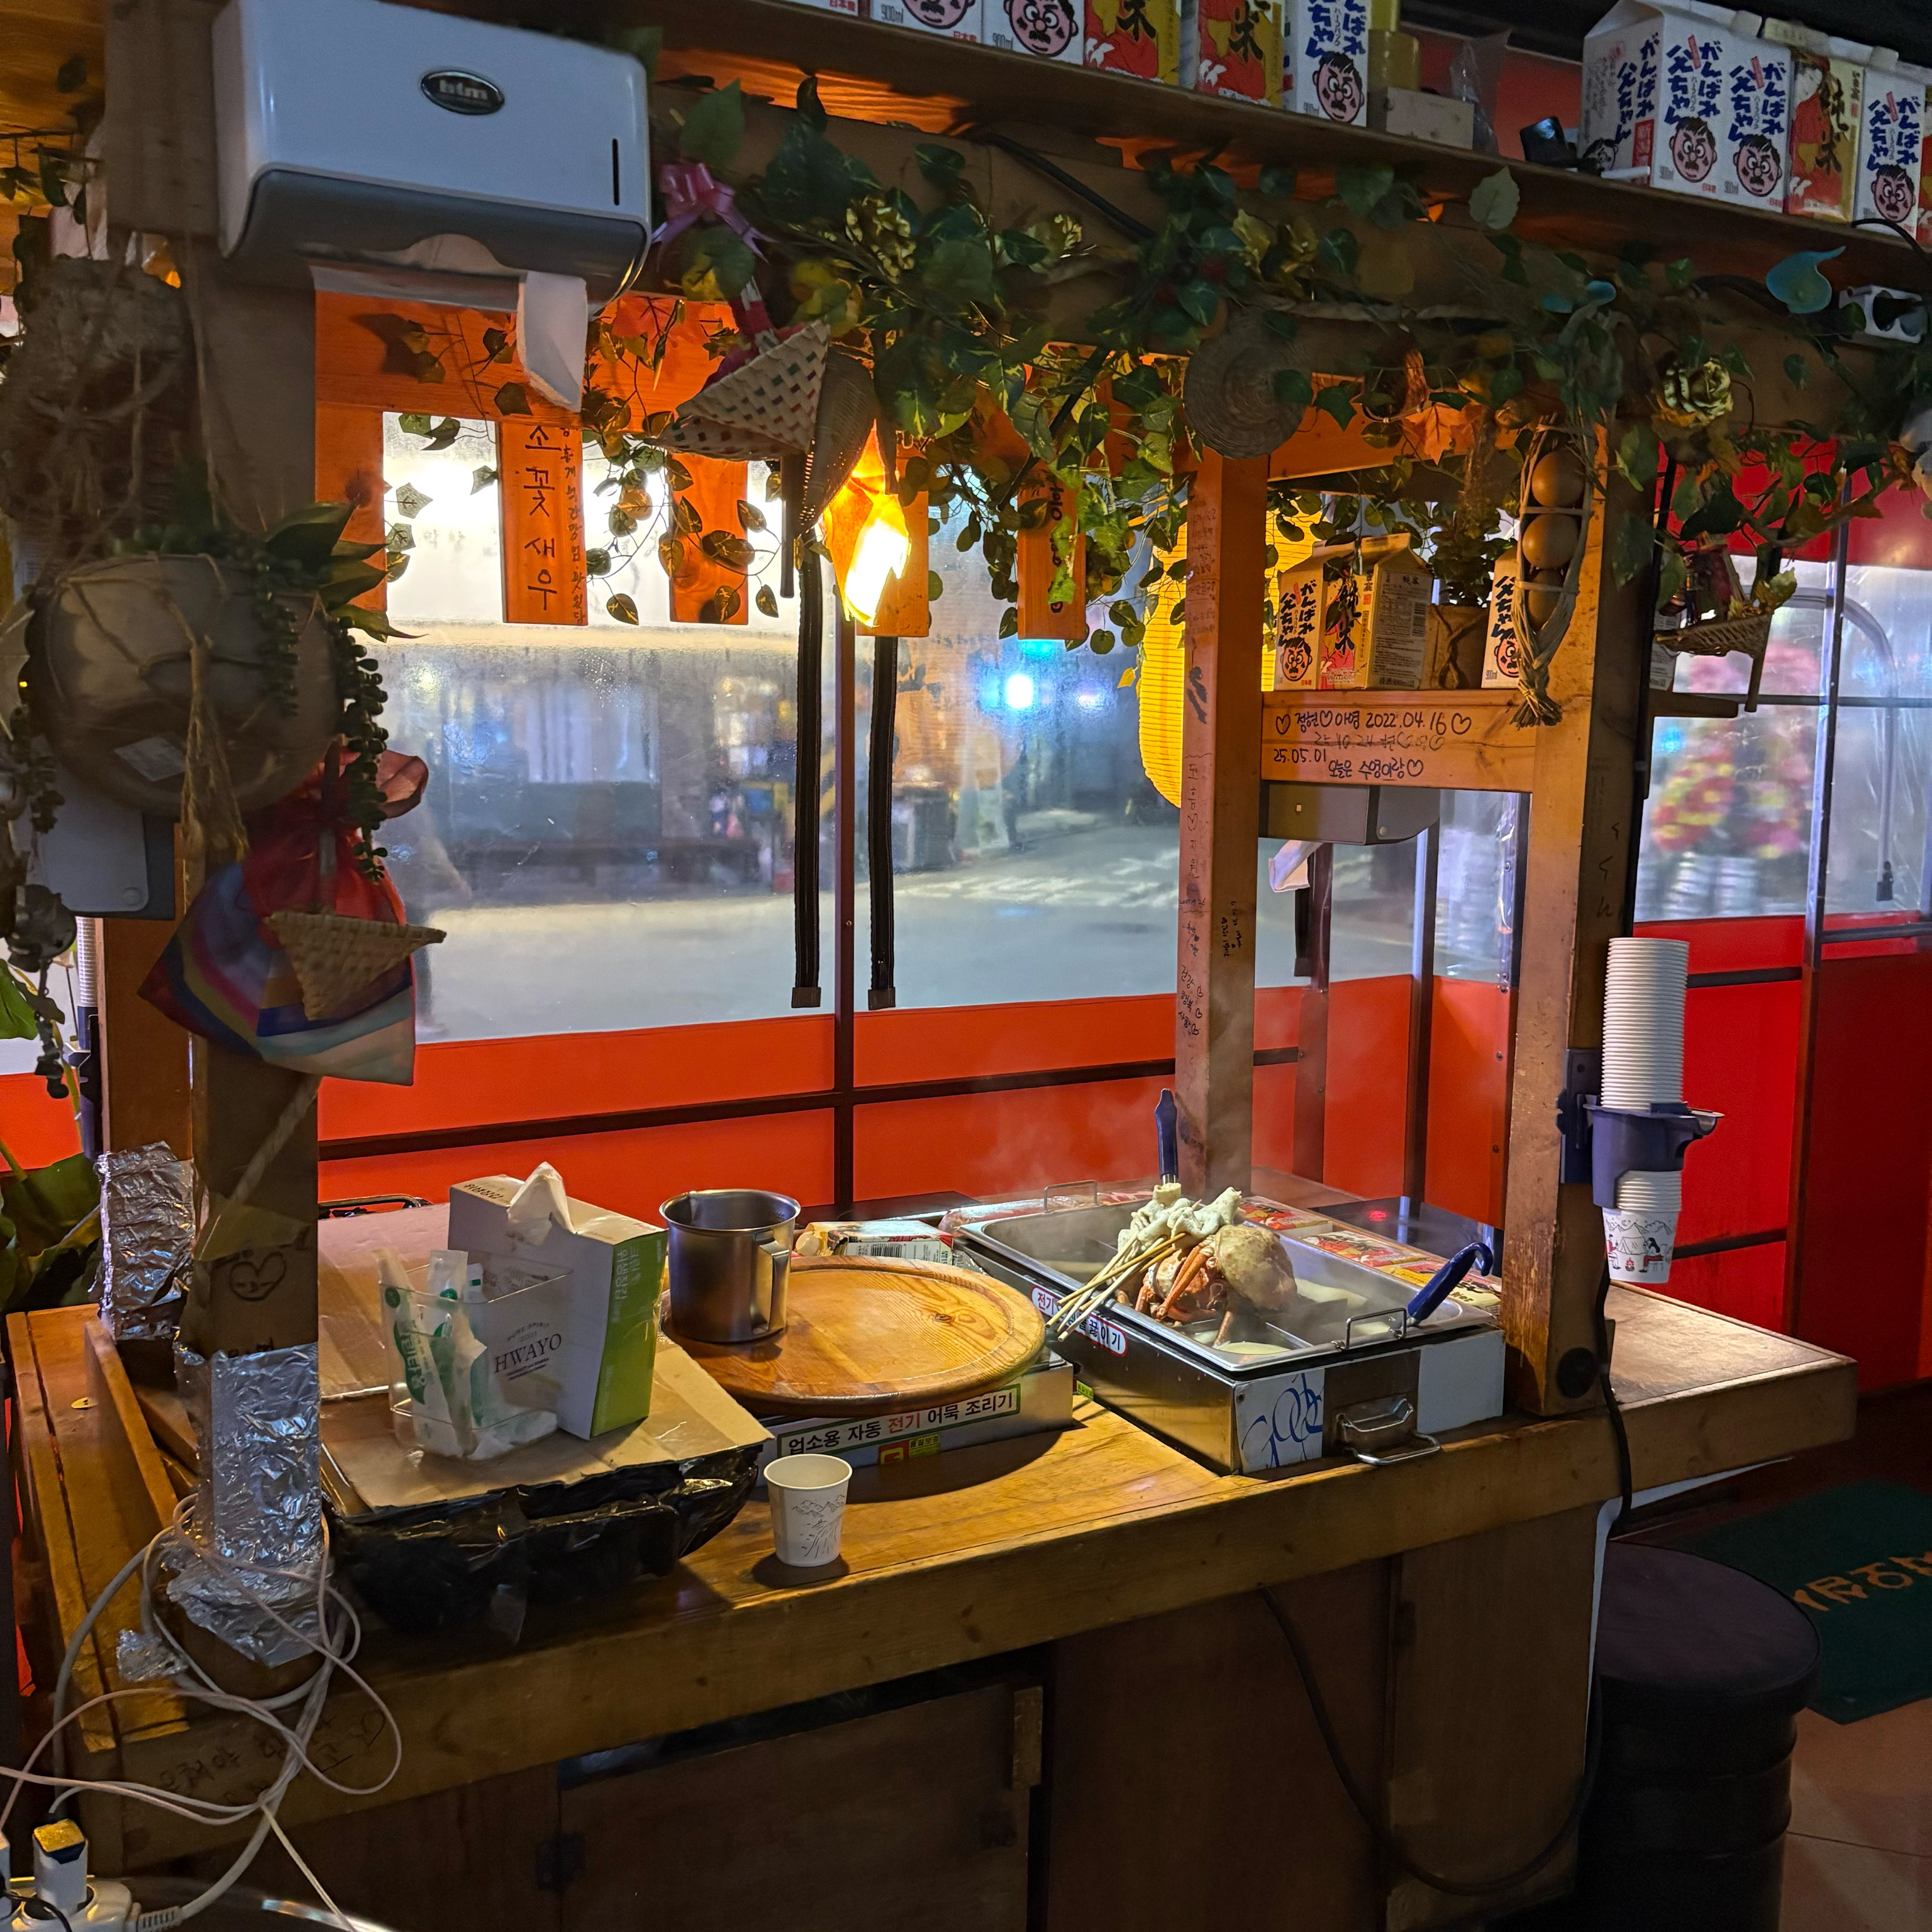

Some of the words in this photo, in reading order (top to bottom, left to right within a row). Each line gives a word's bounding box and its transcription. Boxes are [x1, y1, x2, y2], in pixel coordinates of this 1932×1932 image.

[881, 4, 904, 23] 900ml
[1305, 0, 1335, 58] ちゃん
[1343, 0, 1366, 55] んばれ
[1664, 44, 1695, 126] 父ちゃん
[1697, 40, 1723, 118] がんばれ
[1728, 65, 1757, 142] 父ちゃん
[1762, 62, 1786, 135] がんばれ
[1866, 99, 1891, 171] 父ちゃん
[1896, 96, 1920, 165] がんばれ
[1278, 592, 1297, 648] 父ちゃん
[1298, 579, 1317, 635] がんばれ
[1485, 670, 1497, 680] 900ml
[1274, 748, 1326, 763] 25.05.01
[1328, 759, 1352, 779] 오늘은
[1180, 991, 1194, 1013] 행복
[1181, 965, 1195, 989] 건강
[1038, 1292, 1054, 1316] 전기
[494, 1333, 562, 1374] HWAYO
[788, 1428, 841, 1456] 업소용
[848, 1420, 881, 1443] 자동
[888, 1412, 921, 1434] 전기
[928, 1404, 960, 1425] 어묵
[965, 1392, 1013, 1415] 조리기
